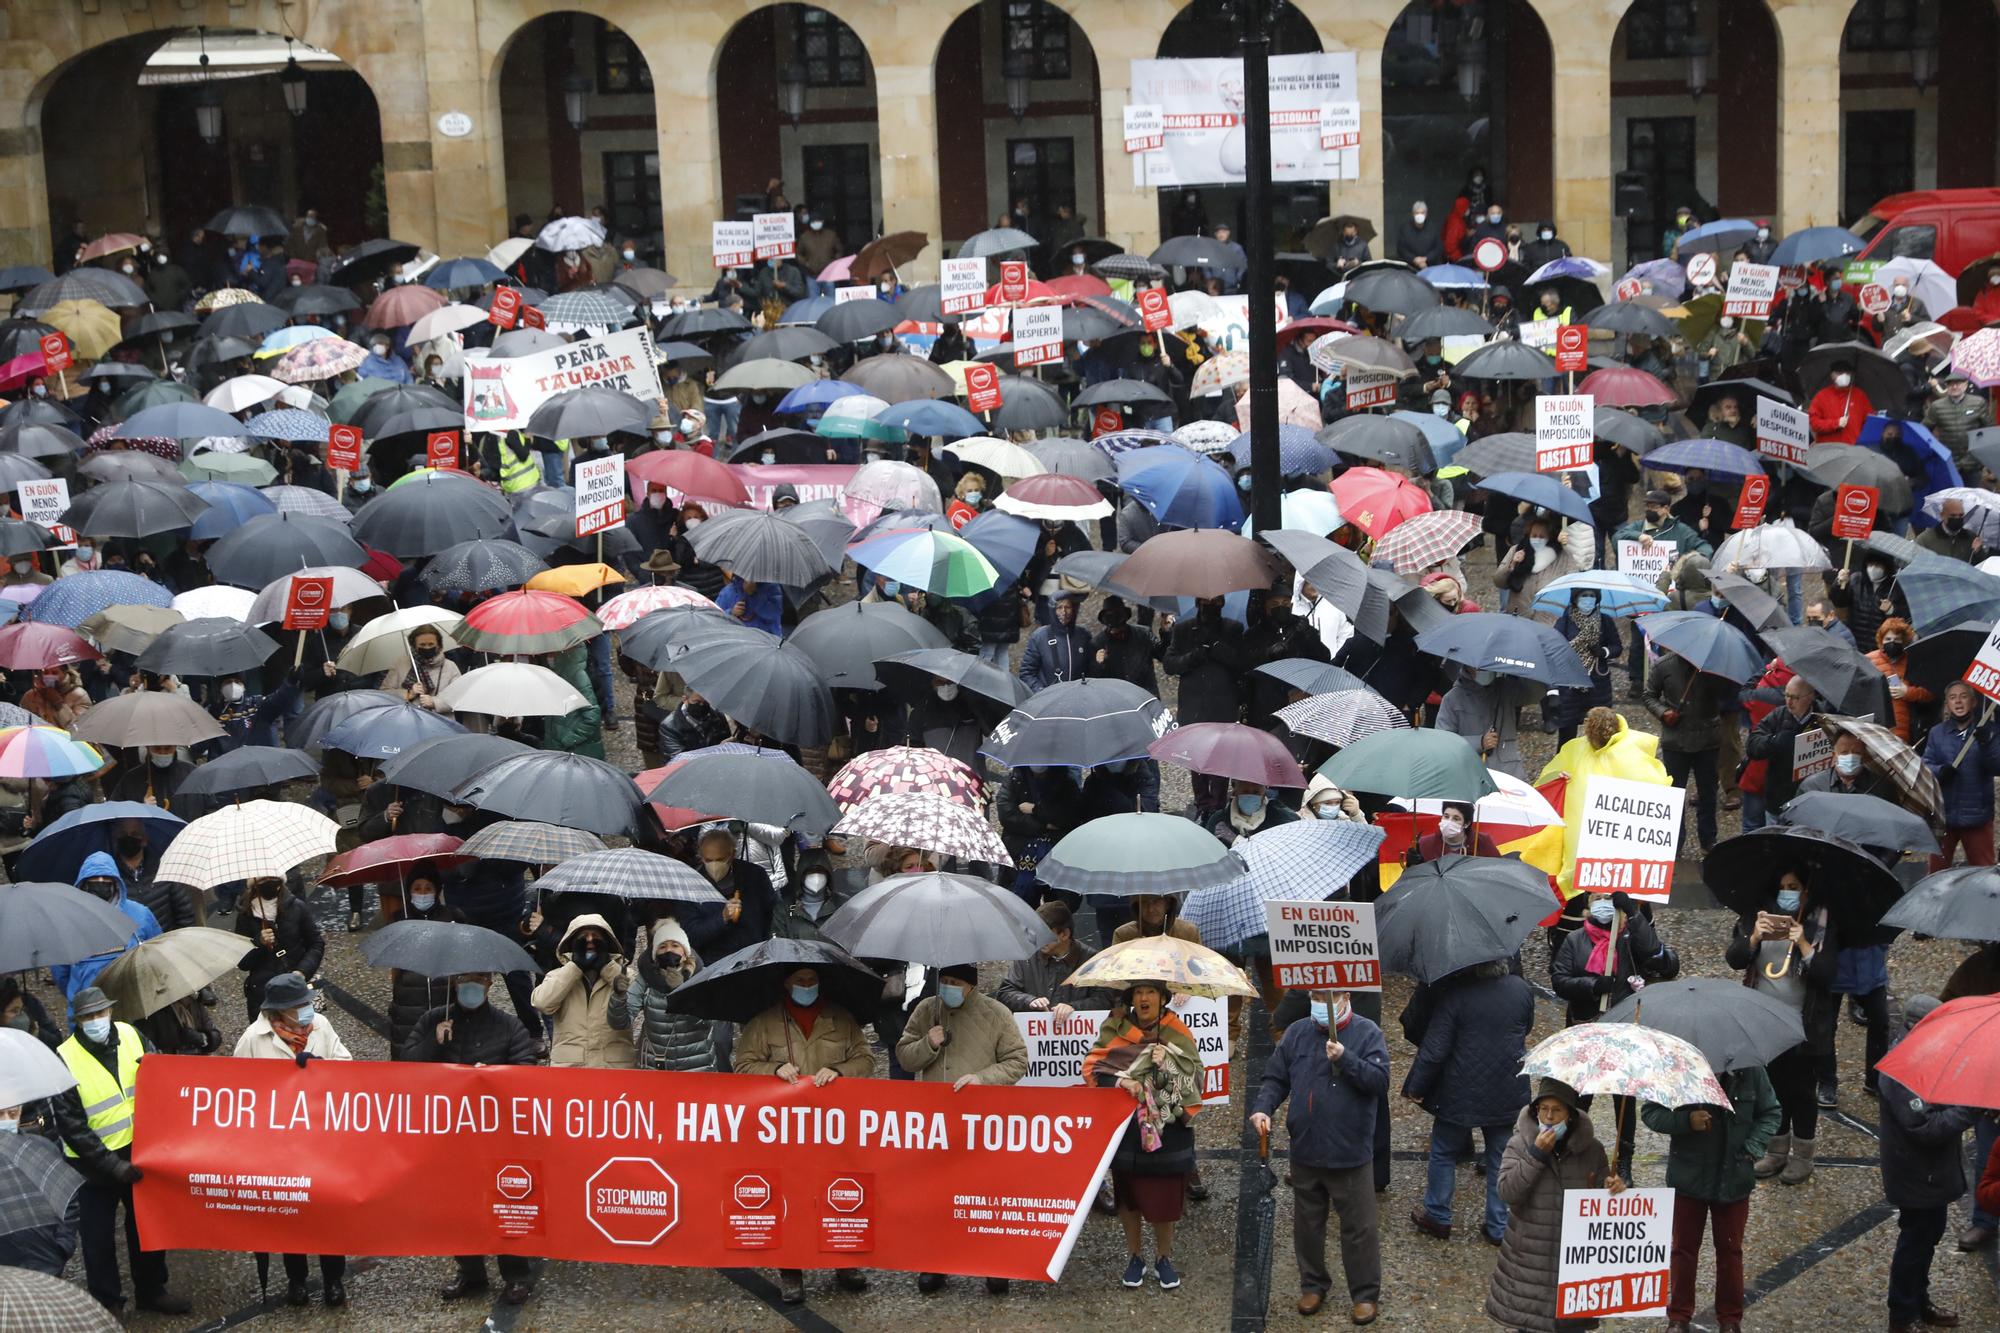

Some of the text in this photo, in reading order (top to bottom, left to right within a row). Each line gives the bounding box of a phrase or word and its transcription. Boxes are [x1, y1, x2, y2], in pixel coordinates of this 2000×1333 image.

[1163, 115, 1233, 128] NGAMOS FIN A
[1126, 137, 1149, 151] BASTA
[1323, 134, 1345, 149] BASTA
[716, 254, 738, 267] BASTA
[947, 263, 957, 272] EN
[951, 272, 976, 280] MENOS
[1737, 267, 1748, 275] EN
[943, 281, 985, 291] IMPOSICIÓN
[1740, 277, 1766, 287] MENOS
[1729, 286, 1773, 298] IMPOSICIÓN
[944, 293, 984, 314] BASTA YA!
[1726, 302, 1769, 314] BASTA YA!
[1016, 326, 1060, 339] DESPIERTA!
[554, 343, 610, 370] PEÑA
[1017, 343, 1060, 366] BASTA YA!
[1350, 385, 1393, 408] BASTA YA!
[1544, 400, 1556, 412] EN
[1550, 414, 1580, 426] MENOS
[1539, 426, 1591, 440] IMPOSICIÓN
[1760, 418, 1806, 443] DESPIERTA!
[1760, 440, 1789, 458] BASTA
[1540, 445, 1590, 470] BASTA YA!
[582, 466, 593, 479] EN
[587, 475, 614, 491] MENOS
[25, 486, 36, 496] EN
[578, 484, 623, 506] IMPOSICIÓN
[32, 497, 59, 509] MENOS
[25, 507, 65, 522] IMPOSICIÓ
[579, 502, 622, 534] BASTA YA!
[1626, 546, 1639, 557] EN
[1632, 559, 1663, 571] MENOS
[1494, 656, 1536, 669] INESIS
[1806, 731, 1822, 743] EN
[1595, 794, 1671, 820] ALCALDESA
[1588, 819, 1672, 847] VETE A CASA
[1578, 862, 1668, 889] BASTA YA!
[1281, 906, 1360, 925] EN GIJÓN,
[1293, 924, 1351, 938] MENOS
[1275, 939, 1373, 955] IMPOSICIÓN
[1280, 963, 1373, 986] BASTA YA!
[1028, 1015, 1099, 1038] EN GIJÓN,
[1038, 1040, 1090, 1057] MENOS
[1025, 1060, 1083, 1077] MPOSIC
[269, 1089, 310, 1130] LA
[324, 1091, 500, 1134] MOVILIDAD
[512, 1096, 552, 1137] EN
[565, 1093, 663, 1144] GIJÓN,
[676, 1102, 746, 1143] HAY
[757, 1105, 846, 1145] SITIO
[859, 1109, 949, 1150] PARA
[188, 1173, 312, 1188] CONTRA LA PEATONALIZACIÓN
[190, 1186, 310, 1202] DEL MURO Y AVDA. EL MOLINÓN.
[205, 1202, 299, 1215] La Ronda Norte de Gijón
[954, 1195, 1076, 1210] CONTRA LA PEATONALIZACIÓN
[1579, 1194, 1657, 1218] EN GIJÓN,
[596, 1206, 667, 1216] PLATAFORMA CIUDADANA
[954, 1209, 968, 1219] DEL
[970, 1210, 993, 1220] MURO
[994, 1211, 1000, 1220] Y
[1002, 1211, 1024, 1222] AVDA.
[1027, 1212, 1037, 1222] EL
[979, 1226, 1004, 1234] Ronda
[1006, 1227, 1029, 1236] Norte
[1031, 1228, 1040, 1236] de
[1042, 1229, 1062, 1239] Gijón
[1588, 1221, 1646, 1240] MENOS
[1565, 1241, 1666, 1265] IMPOSICIÓN
[1563, 1275, 1662, 1315] BASTA YA!
